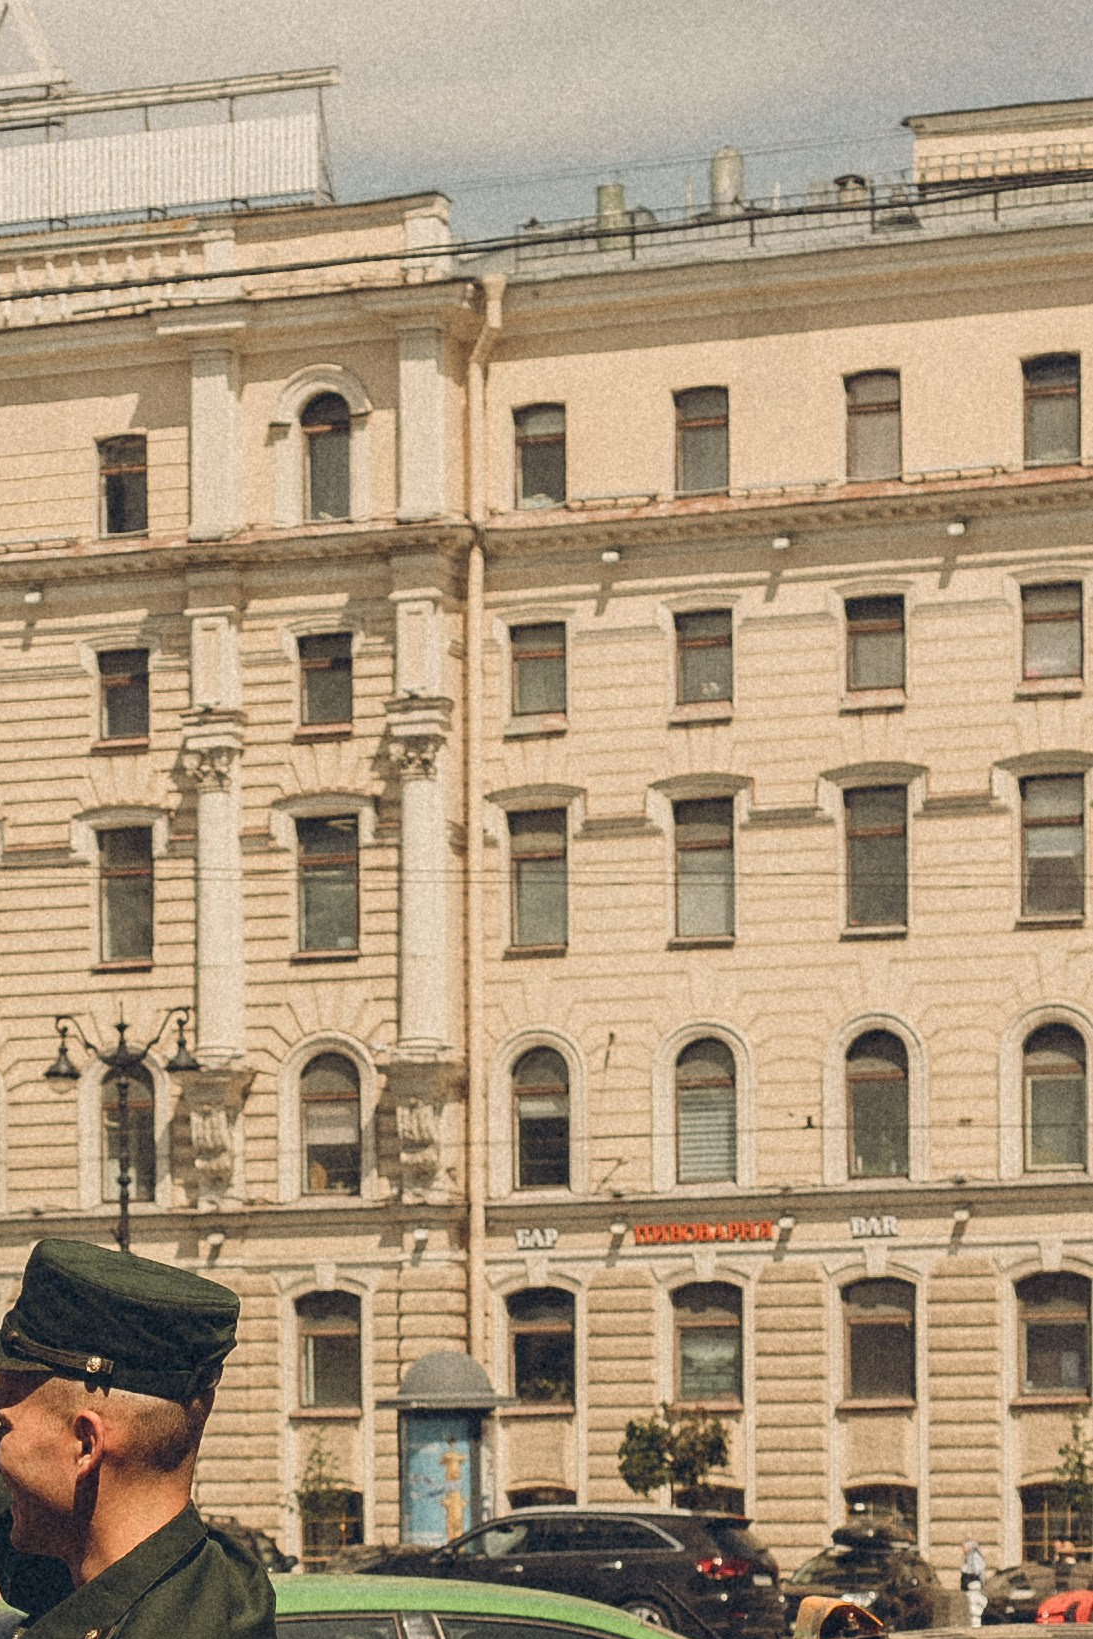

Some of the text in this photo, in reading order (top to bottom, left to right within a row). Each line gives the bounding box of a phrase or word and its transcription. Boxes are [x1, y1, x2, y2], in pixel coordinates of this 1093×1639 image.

[634, 1220, 773, 1245] ПИВОВАРНЯ
[850, 1215, 898, 1238] BAR
[515, 1228, 559, 1249] БАР
